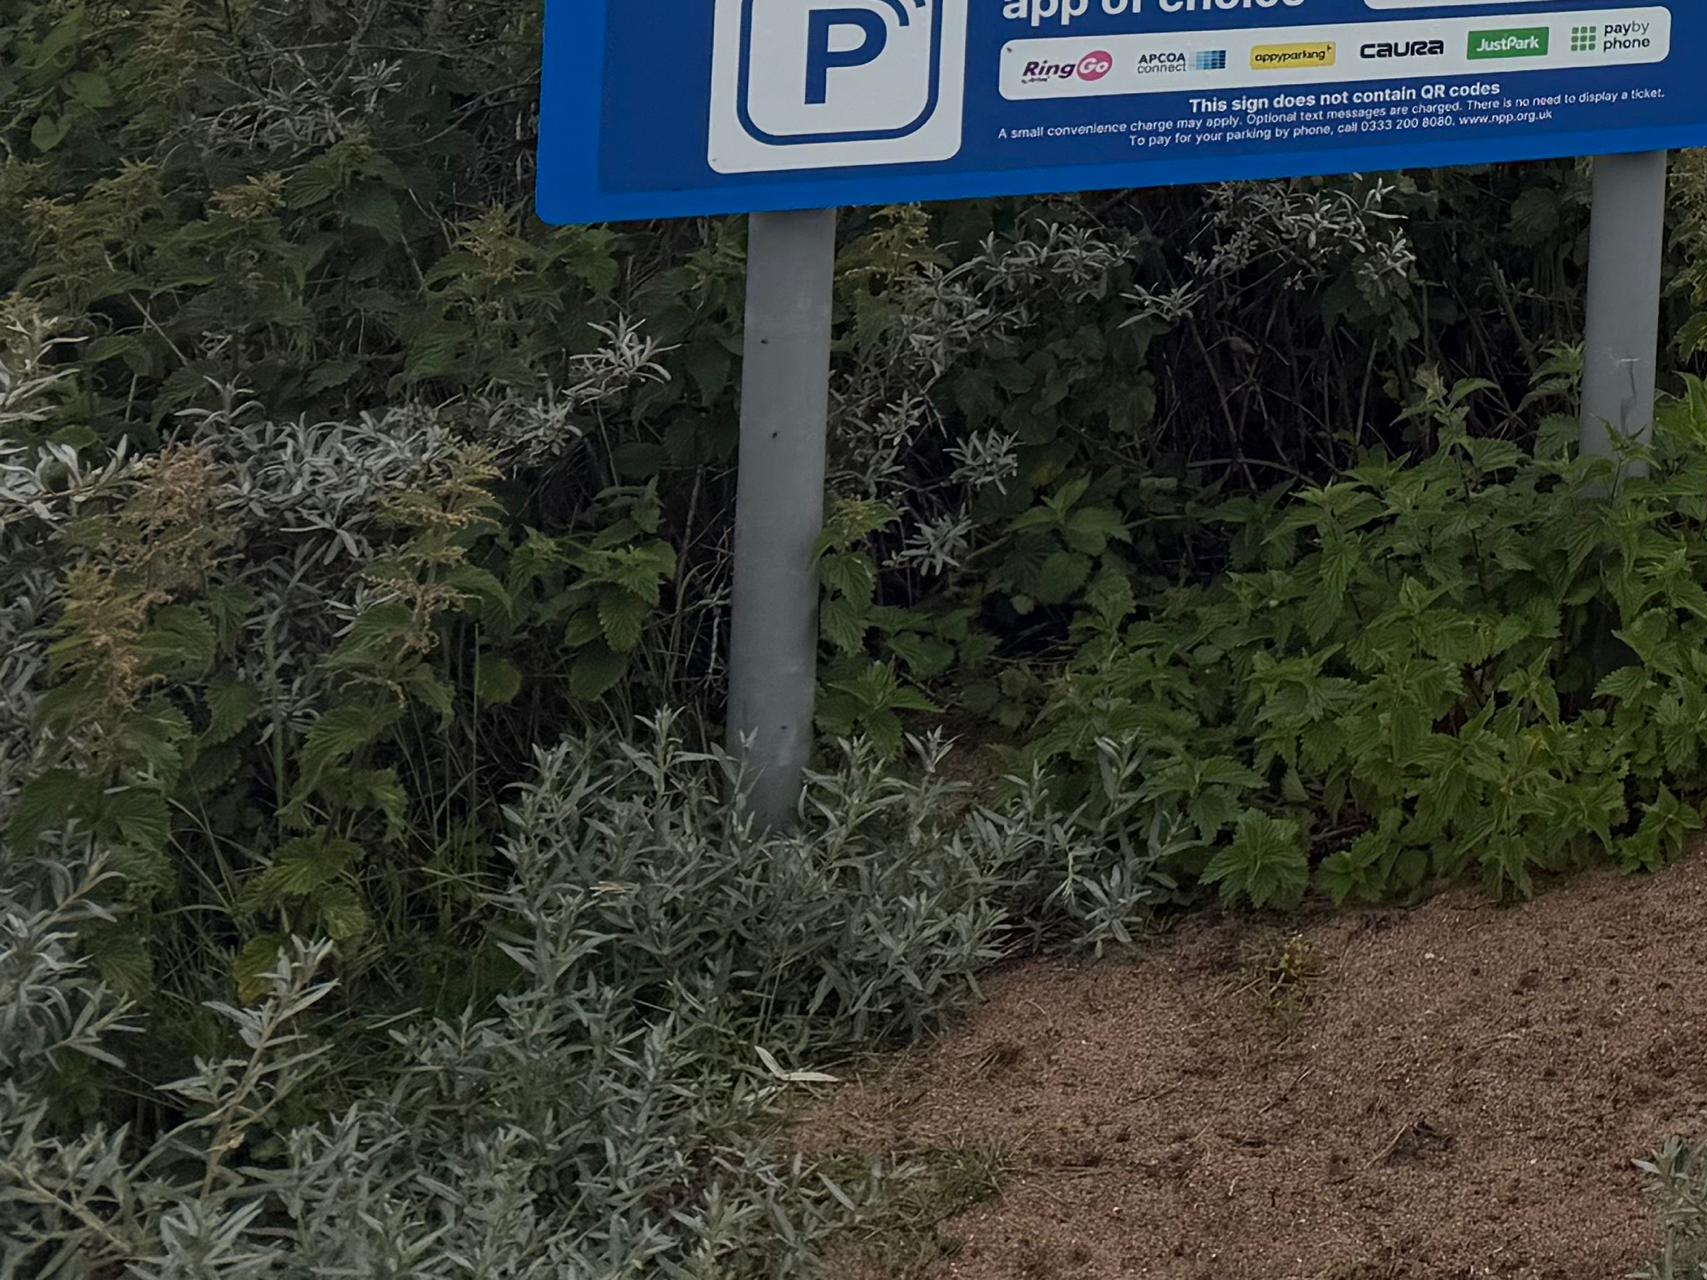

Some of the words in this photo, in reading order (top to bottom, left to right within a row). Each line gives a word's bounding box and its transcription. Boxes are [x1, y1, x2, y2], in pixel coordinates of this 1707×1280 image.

[1476, 34, 1540, 53] JustPark
[806, 10, 886, 104] P
[1138, 52, 1186, 64] APCOA
[1022, 57, 1110, 79] RingGo
[1137, 62, 1187, 74] connect
[1188, 96, 1228, 114] This
[1231, 94, 1269, 115] sign
[1272, 92, 1316, 110] does
[1320, 90, 1349, 107] not
[1352, 85, 1417, 104] contain
[1420, 83, 1446, 100] QR
[1450, 82, 1501, 98] codes
